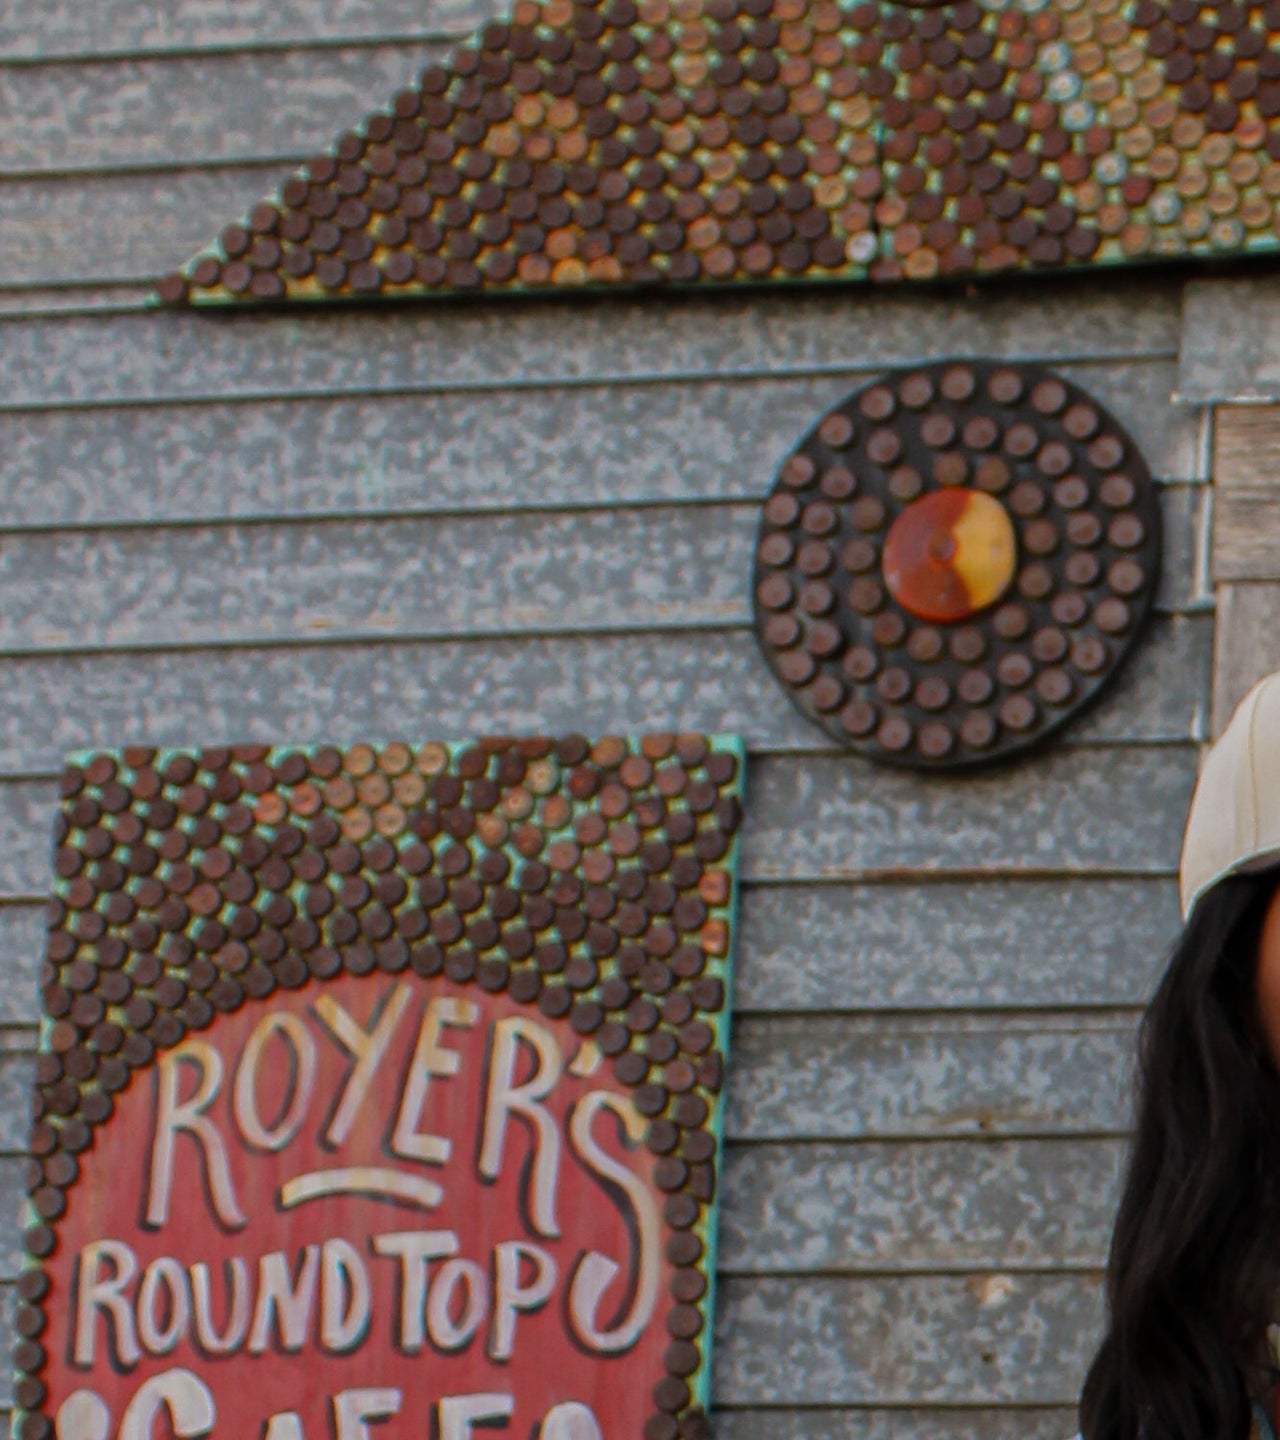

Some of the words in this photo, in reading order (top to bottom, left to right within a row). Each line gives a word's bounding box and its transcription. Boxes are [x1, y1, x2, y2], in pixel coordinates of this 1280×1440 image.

[147, 984, 660, 1350] ROYER'S
[73, 1238, 372, 1365] ROUND
[371, 1230, 558, 1360] TOP
